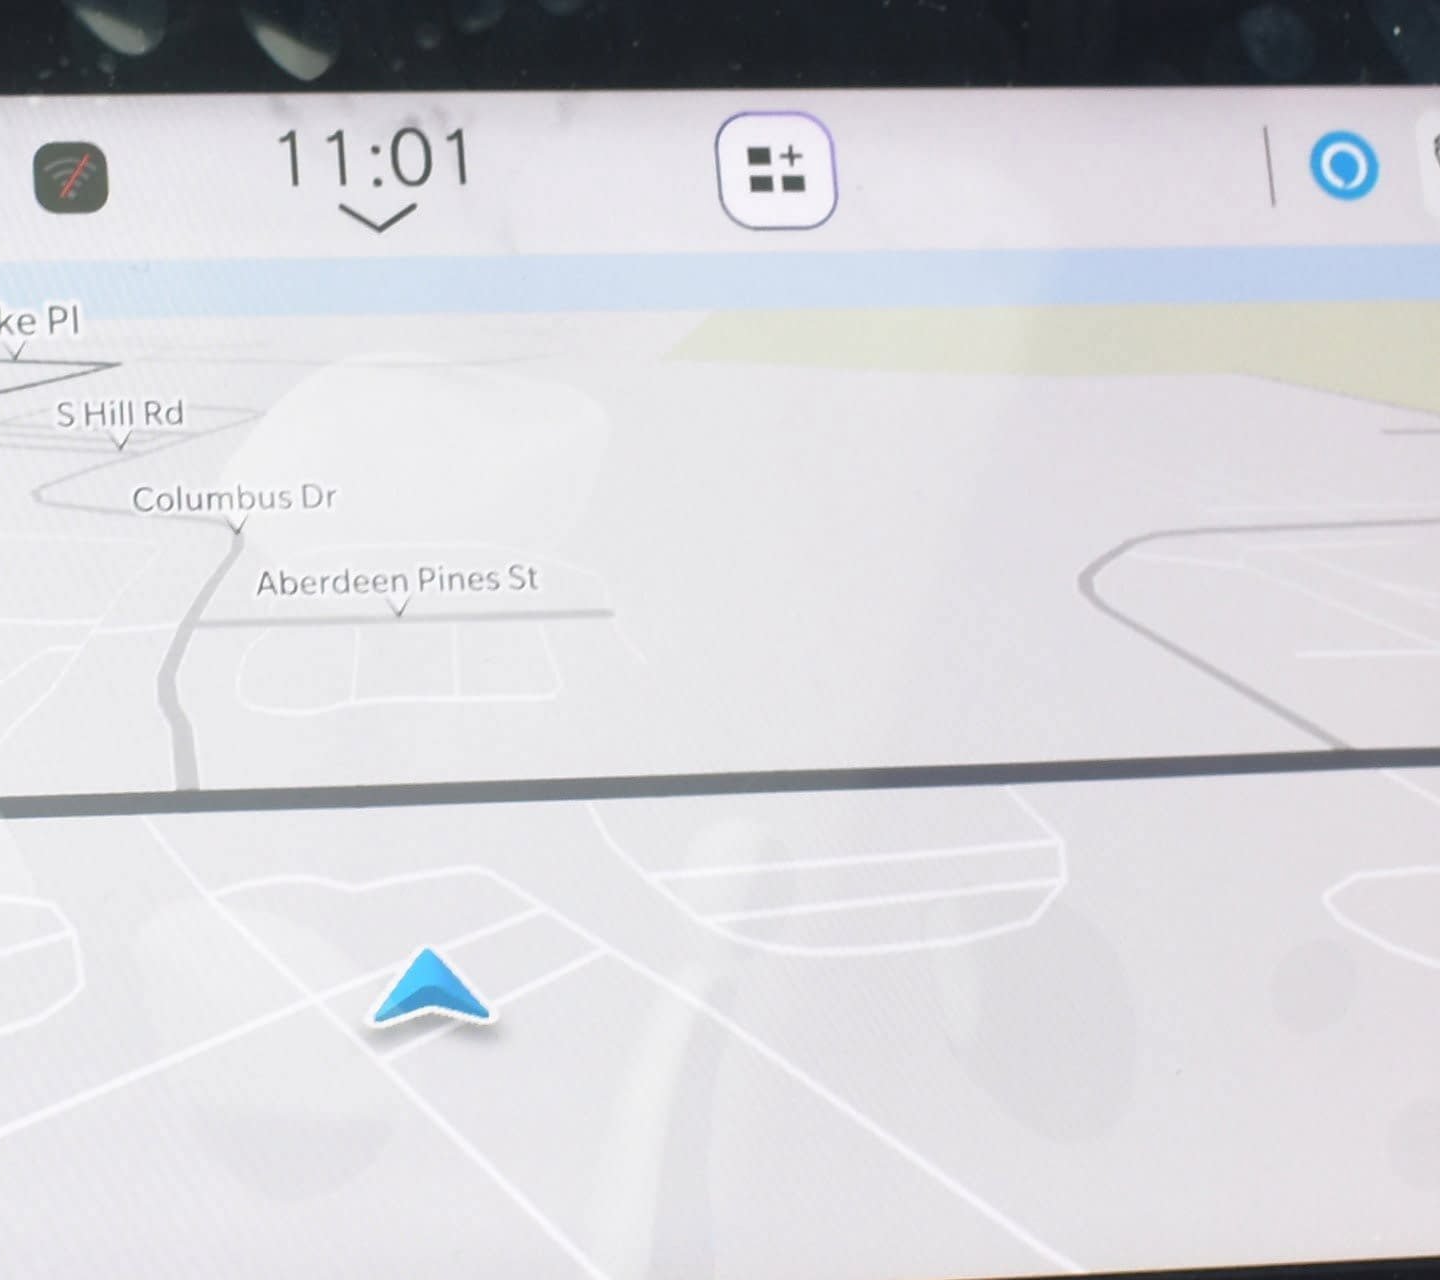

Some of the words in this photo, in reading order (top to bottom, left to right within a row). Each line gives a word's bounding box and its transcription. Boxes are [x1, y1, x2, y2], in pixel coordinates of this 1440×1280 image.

[278, 126, 471, 189] 11:01
[49, 304, 78, 334] Pl
[57, 402, 77, 428] S
[84, 401, 134, 428] Hill
[145, 400, 184, 426] Rd
[132, 483, 293, 513] Columbus
[302, 484, 337, 510] Dr
[257, 568, 408, 596] Aberdeen
[419, 566, 500, 593] Pines
[509, 564, 539, 591] St
